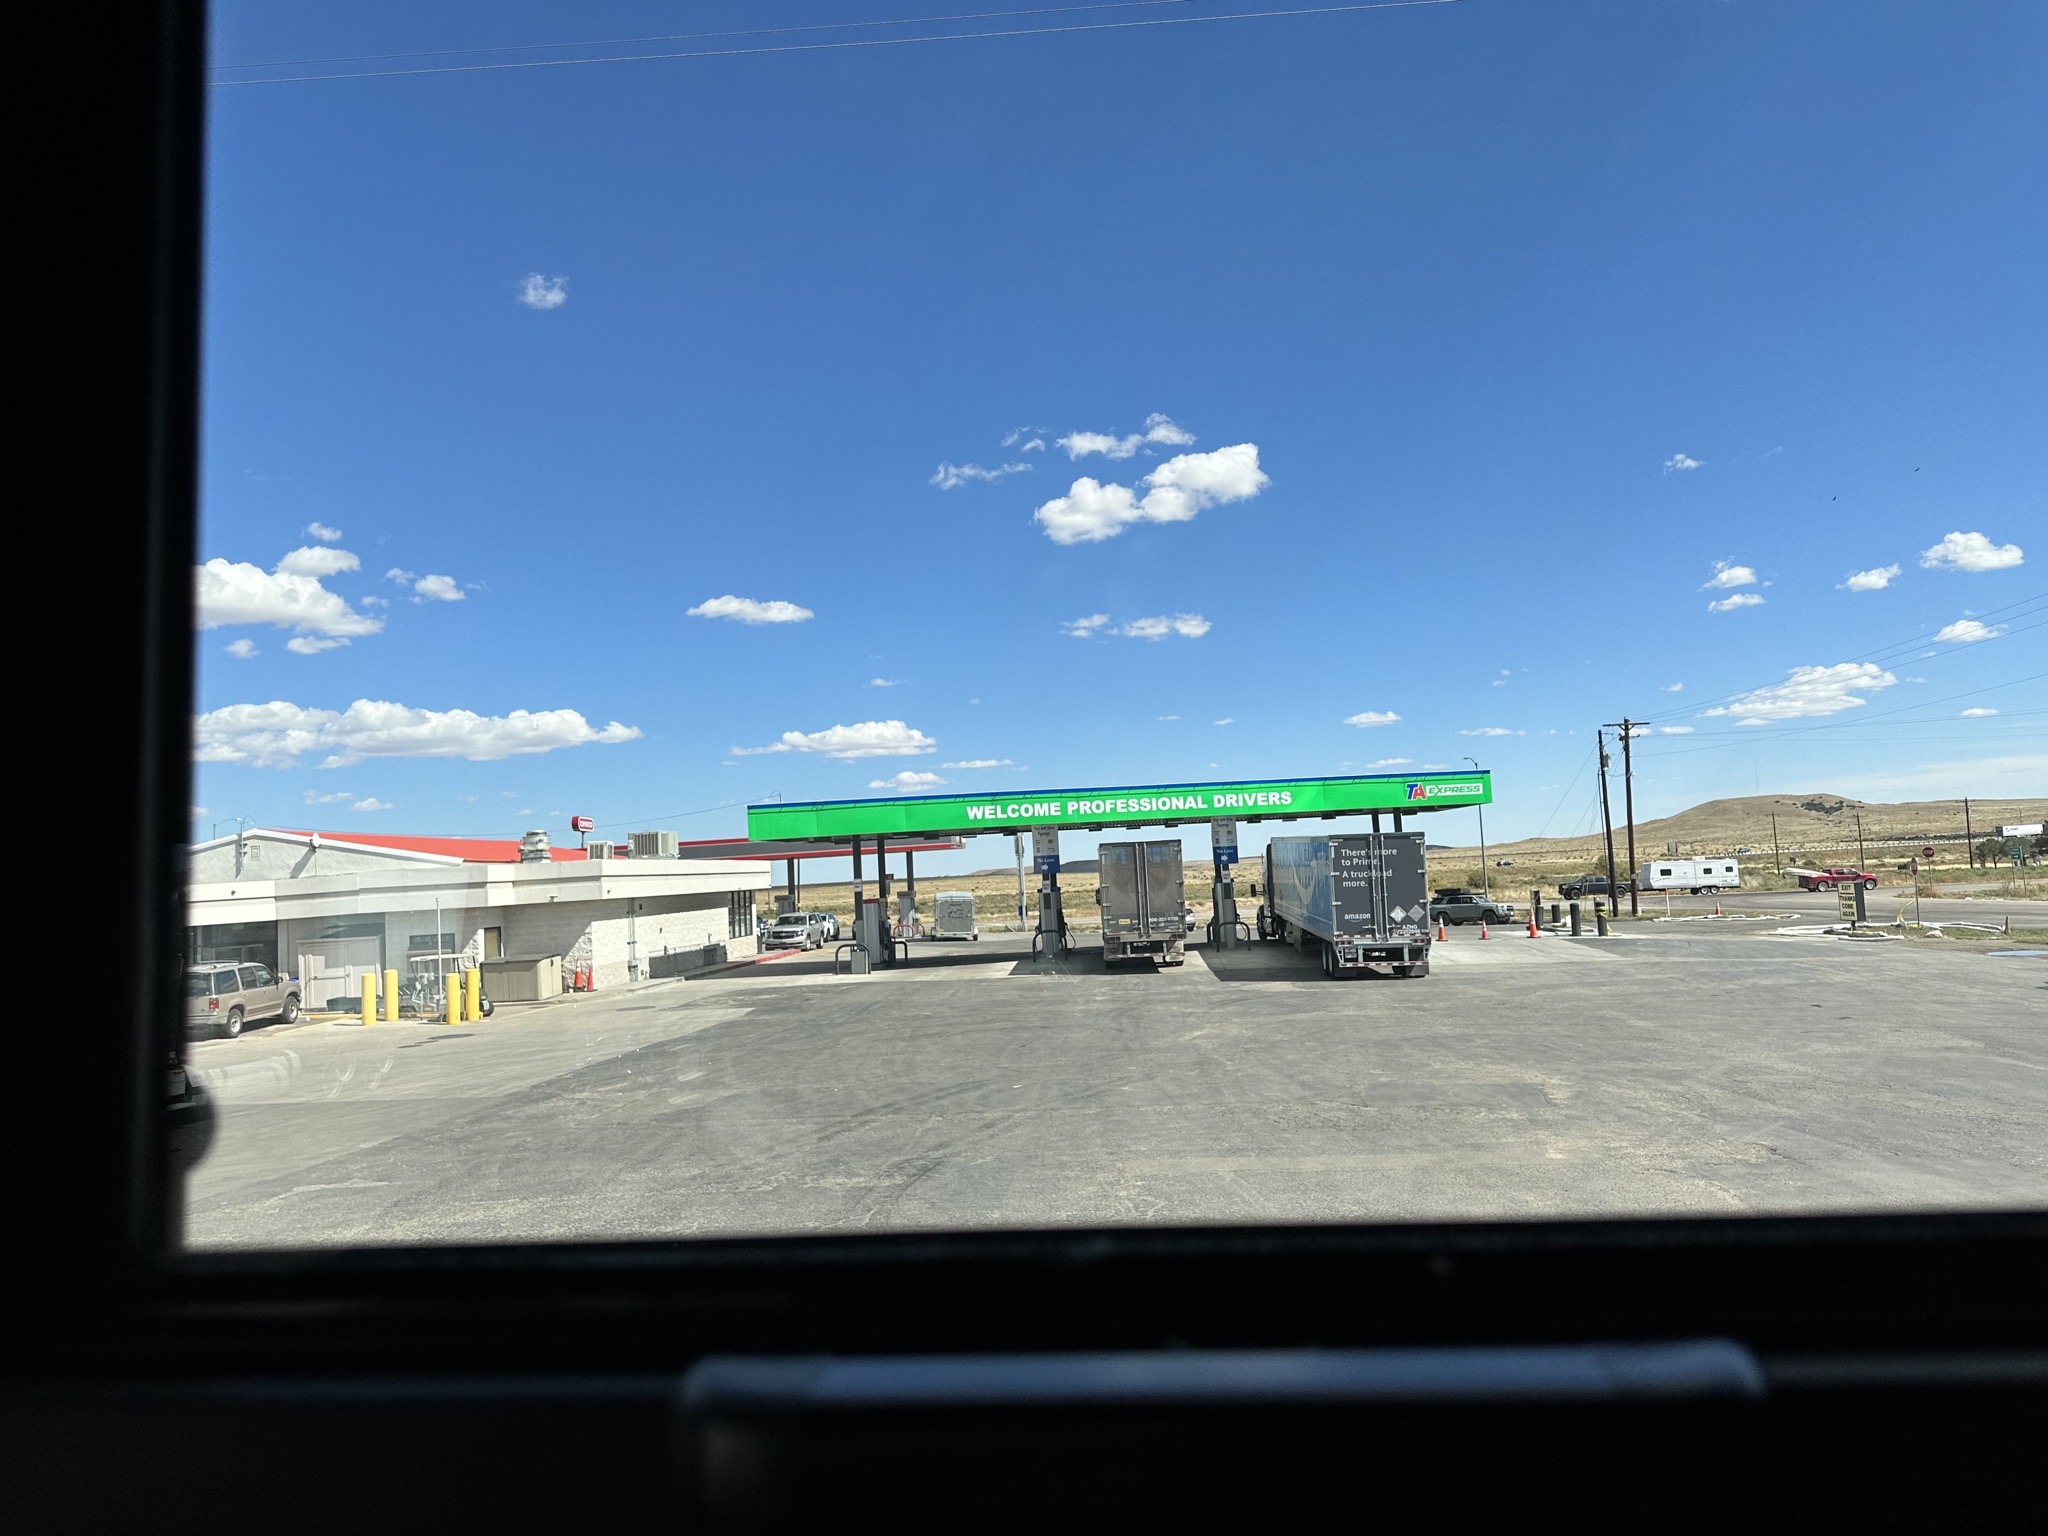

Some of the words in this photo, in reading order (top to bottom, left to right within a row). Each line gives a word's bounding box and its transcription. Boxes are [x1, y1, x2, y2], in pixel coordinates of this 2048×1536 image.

[1406, 783, 1427, 801] TA
[1428, 785, 1481, 796] EXPRESS
[966, 802, 1061, 820] WELCOME
[1067, 795, 1208, 815] PROFESSIONAL
[1213, 791, 1292, 808] DRIVERS
[1340, 848, 1371, 857] There's
[1374, 848, 1398, 856] more
[1342, 870, 1349, 878] A
[1342, 880, 1369, 888] more.
